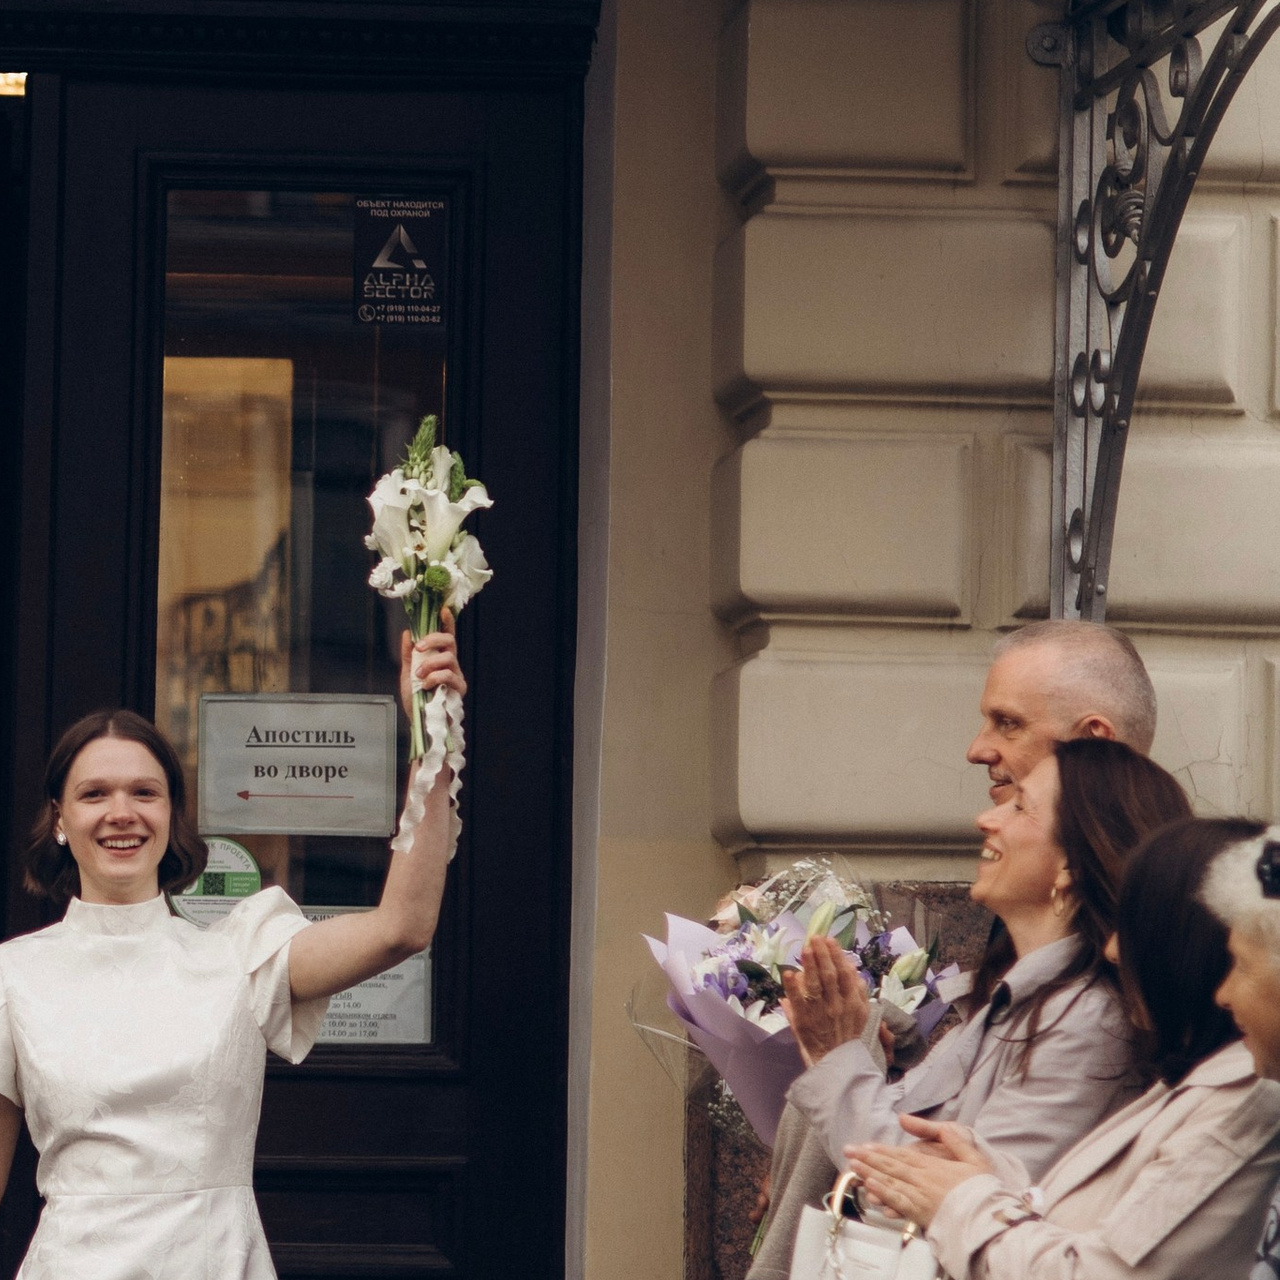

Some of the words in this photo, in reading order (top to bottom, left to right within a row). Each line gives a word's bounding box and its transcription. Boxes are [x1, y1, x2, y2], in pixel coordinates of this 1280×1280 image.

[356, 200, 391, 208] ОБЪЕКТ
[393, 200, 444, 209] НАХОДИТСЯ
[370, 209, 389, 217] ПОД
[390, 209, 430, 218] ОХРАНОЙ
[363, 272, 435, 286] ALPHA
[363, 286, 435, 299] SECTOR
[376, 304, 385, 312] +7
[376, 314, 385, 322] +7
[245, 725, 356, 744] Апостиль
[254, 764, 278, 778] во
[284, 764, 348, 783] дворе
[220, 843, 252, 870] ПРОЕКТА
[342, 1001, 361, 1009] 14.00
